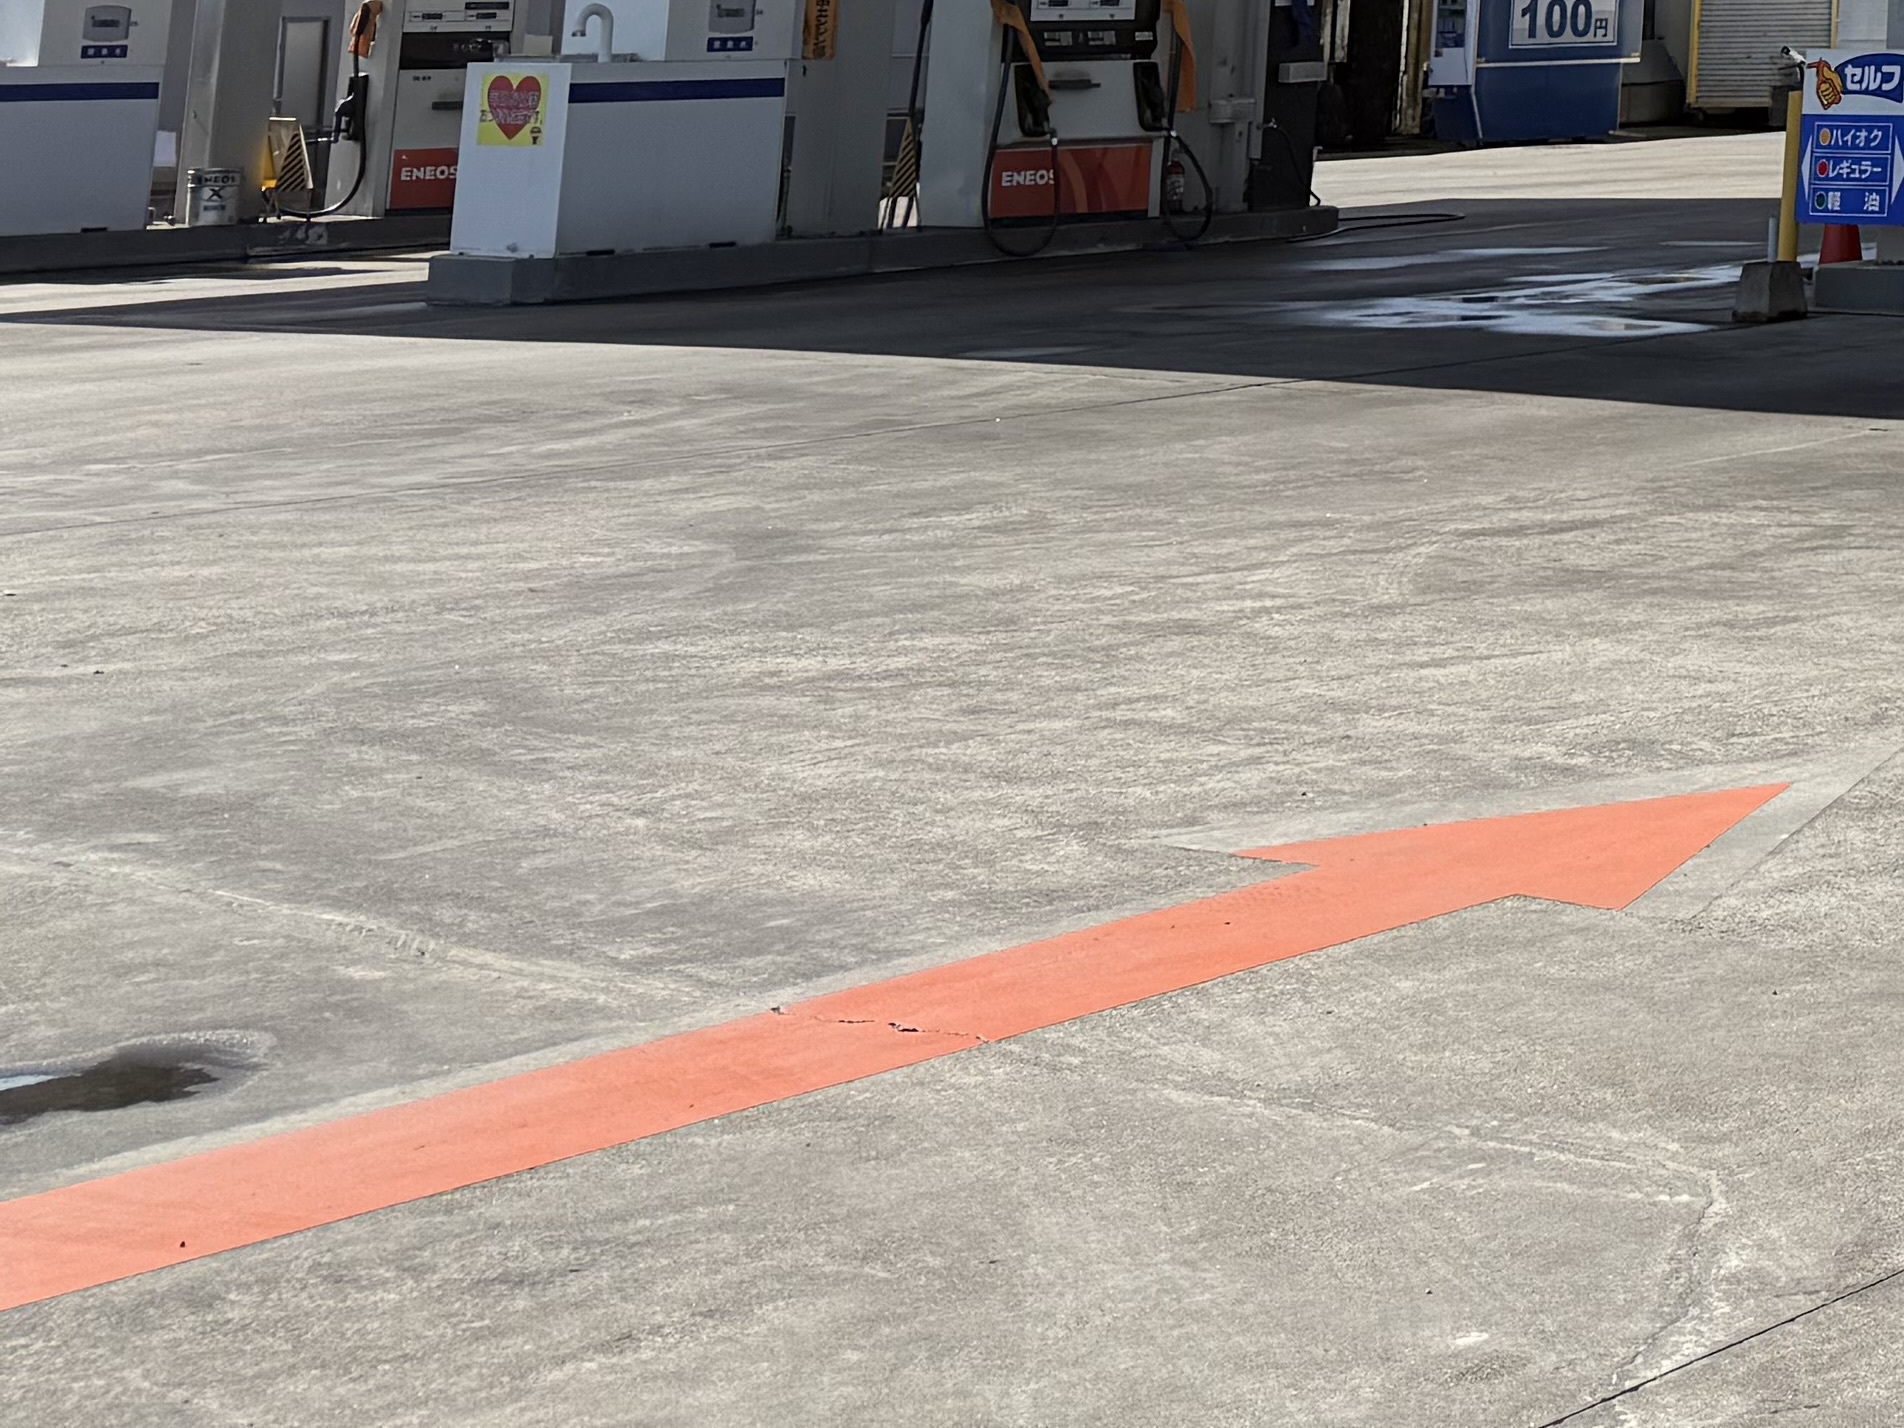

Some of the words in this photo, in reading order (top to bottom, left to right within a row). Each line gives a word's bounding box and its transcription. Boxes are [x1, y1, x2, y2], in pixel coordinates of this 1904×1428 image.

[1844, 64, 1902, 92] セルフ
[1830, 127, 1883, 148] ハイオク
[400, 165, 458, 182] ENEOS
[1827, 159, 1883, 179] レギュラー
